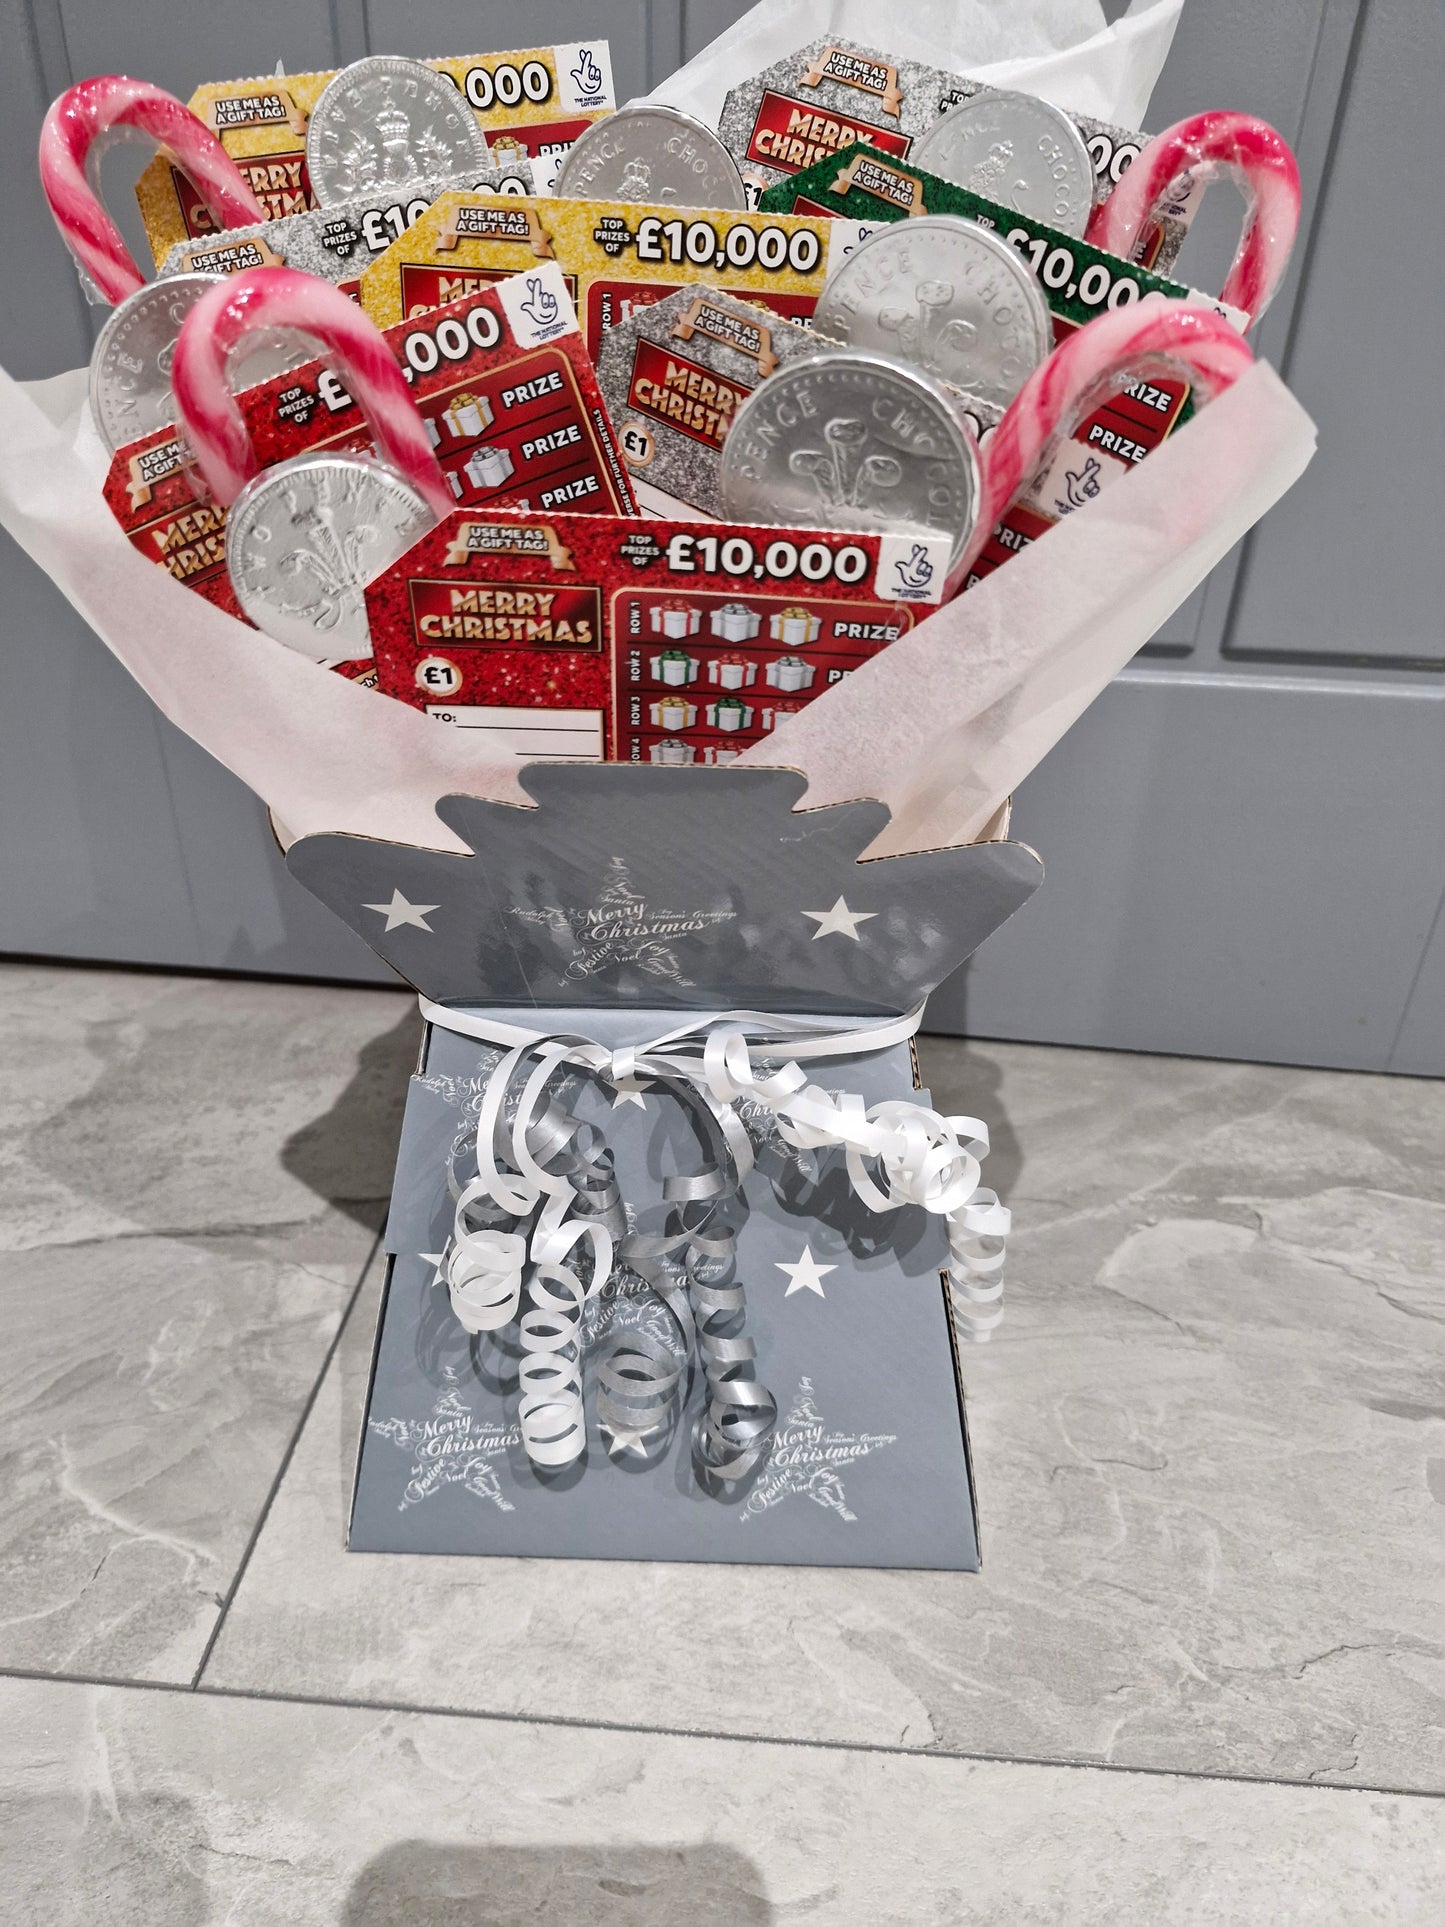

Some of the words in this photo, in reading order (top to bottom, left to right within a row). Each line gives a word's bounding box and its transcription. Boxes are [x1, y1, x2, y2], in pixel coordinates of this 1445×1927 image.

[824, 62, 835, 74] A
[834, 65, 862, 82] GIFT
[861, 73, 888, 91] TAG!
[831, 53, 853, 70] USE
[854, 59, 871, 74] ME
[871, 63, 888, 79] AS
[216, 101, 243, 113] USE
[242, 97, 262, 111] ME
[263, 95, 280, 107] AS
[216, 112, 227, 125] A
[226, 109, 255, 123] GIFT
[258, 106, 286, 119] TAG!
[859, 160, 882, 178] USE
[881, 169, 898, 187] ME
[897, 178, 914, 193] AS
[853, 171, 864, 182] A
[862, 174, 888, 194] GIFT
[887, 184, 914, 207] TAG!
[327, 222, 347, 235] TOP
[457, 221, 468, 232] A
[467, 221, 498, 234] GIFT
[499, 222, 530, 236] TAG!
[459, 209, 486, 221] USE
[486, 210, 507, 223] ME
[507, 212, 526, 225] AS
[322, 231, 358, 248] PRIZES
[594, 229, 631, 243] PRIZES
[601, 219, 624, 230] TOP
[636, 217, 819, 272] £10,000
[605, 241, 620, 254] OF
[192, 256, 218, 269] USE
[218, 249, 238, 263] ME
[239, 244, 257, 257] AS
[233, 254, 264, 270] TAG!
[336, 244, 350, 256] OF
[695, 315, 705, 328] A
[704, 320, 732, 340] GIFT
[733, 331, 761, 353] TAG!
[700, 305, 725, 323] USE
[724, 314, 743, 331] ME
[742, 323, 760, 341] AS
[279, 387, 302, 403] TOP
[502, 372, 564, 409] PRIZE
[278, 394, 315, 418] PRIZES
[294, 410, 309, 424] OF
[593, 409, 610, 443] DETAILS
[522, 424, 583, 461] PRIZE
[624, 430, 648, 457] £1
[1088, 424, 1149, 464] PRIZE
[137, 450, 168, 469] USE
[142, 469, 155, 482] A
[154, 455, 185, 475] GIFT
[604, 443, 624, 480] FURTHER
[541, 475, 600, 510] PRIZE
[616, 479, 628, 494] FOR
[467, 537, 481, 548] A
[480, 537, 513, 549] GIFT
[514, 539, 549, 551] TAG!
[469, 526, 499, 538] USE
[499, 527, 523, 539] ME
[523, 529, 544, 540] AS
[620, 545, 660, 557] PRIZES
[628, 535, 652, 545] TOP
[666, 534, 868, 583] £10,000
[632, 555, 648, 566] OF
[450, 589, 556, 617] MERRY
[420, 614, 593, 644] CHRISTMAS
[630, 609, 641, 634] ROW
[834, 622, 900, 641] PRIZE
[423, 666, 453, 685] £1
[630, 658, 641, 682] ROW
[432, 712, 457, 723] TO:
[630, 705, 641, 726] ROW
[570, 903, 648, 927] Merry
[577, 918, 711, 946] Christmas
[410, 1415, 474, 1441] Merry
[762, 1424, 826, 1451] Merry
[415, 1433, 522, 1463] Christmas
[763, 1442, 873, 1473] Christmas
